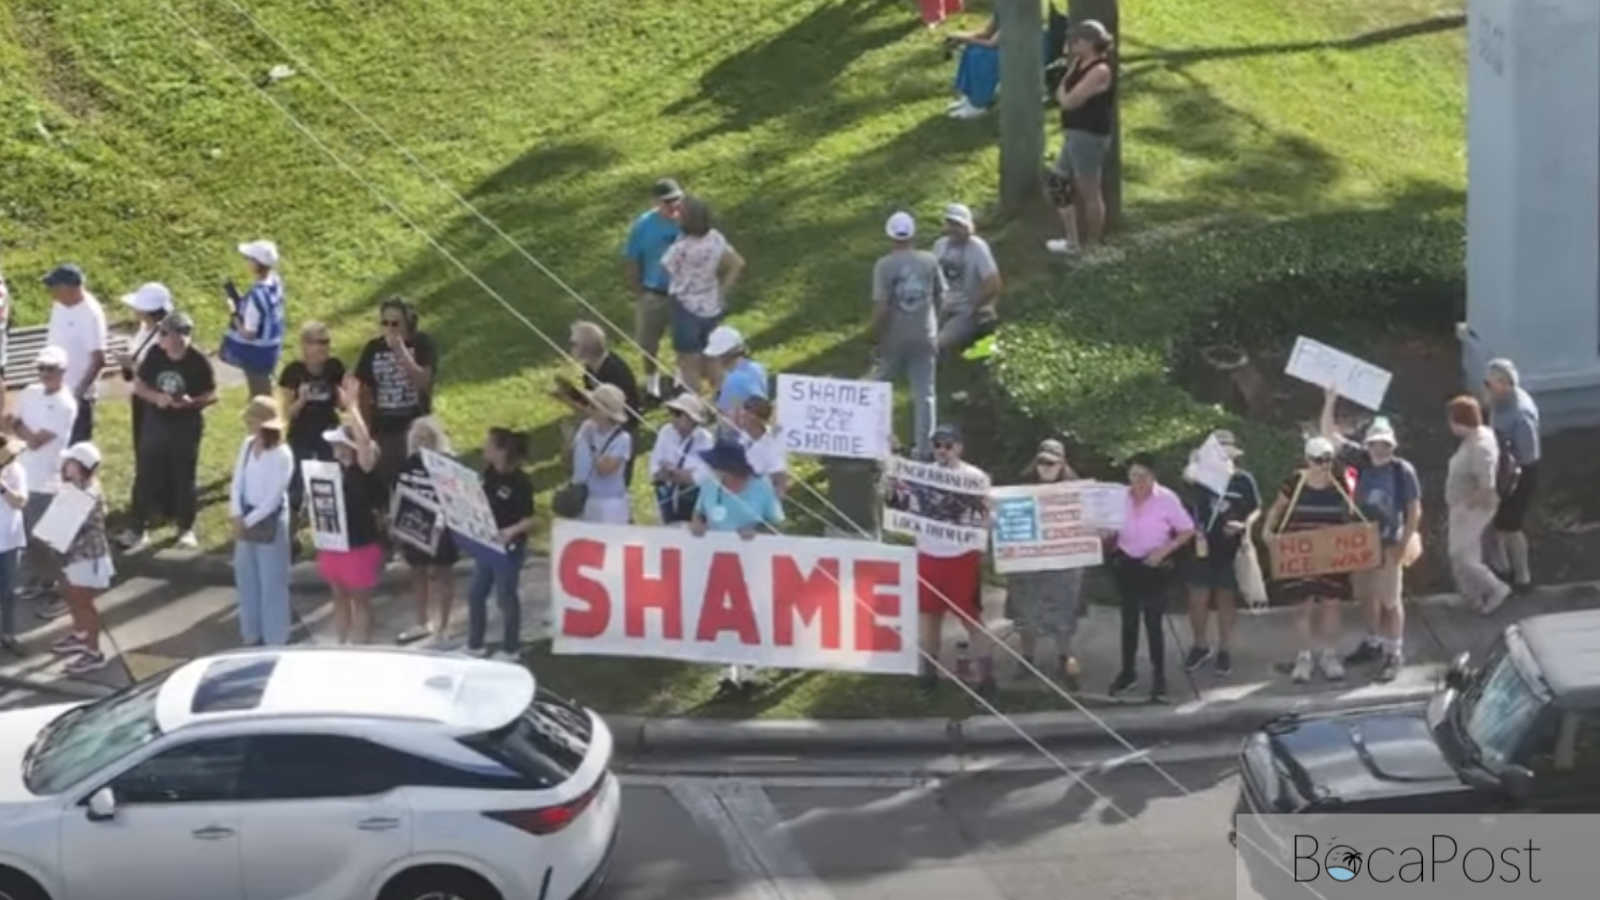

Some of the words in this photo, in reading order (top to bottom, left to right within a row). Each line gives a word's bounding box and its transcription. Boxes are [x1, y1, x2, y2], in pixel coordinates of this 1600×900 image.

[790, 380, 872, 407] SHAME
[804, 416, 852, 432] ICE
[785, 428, 866, 455] SHAME
[1279, 556, 1313, 574] ICE
[558, 537, 902, 653] SHAME
